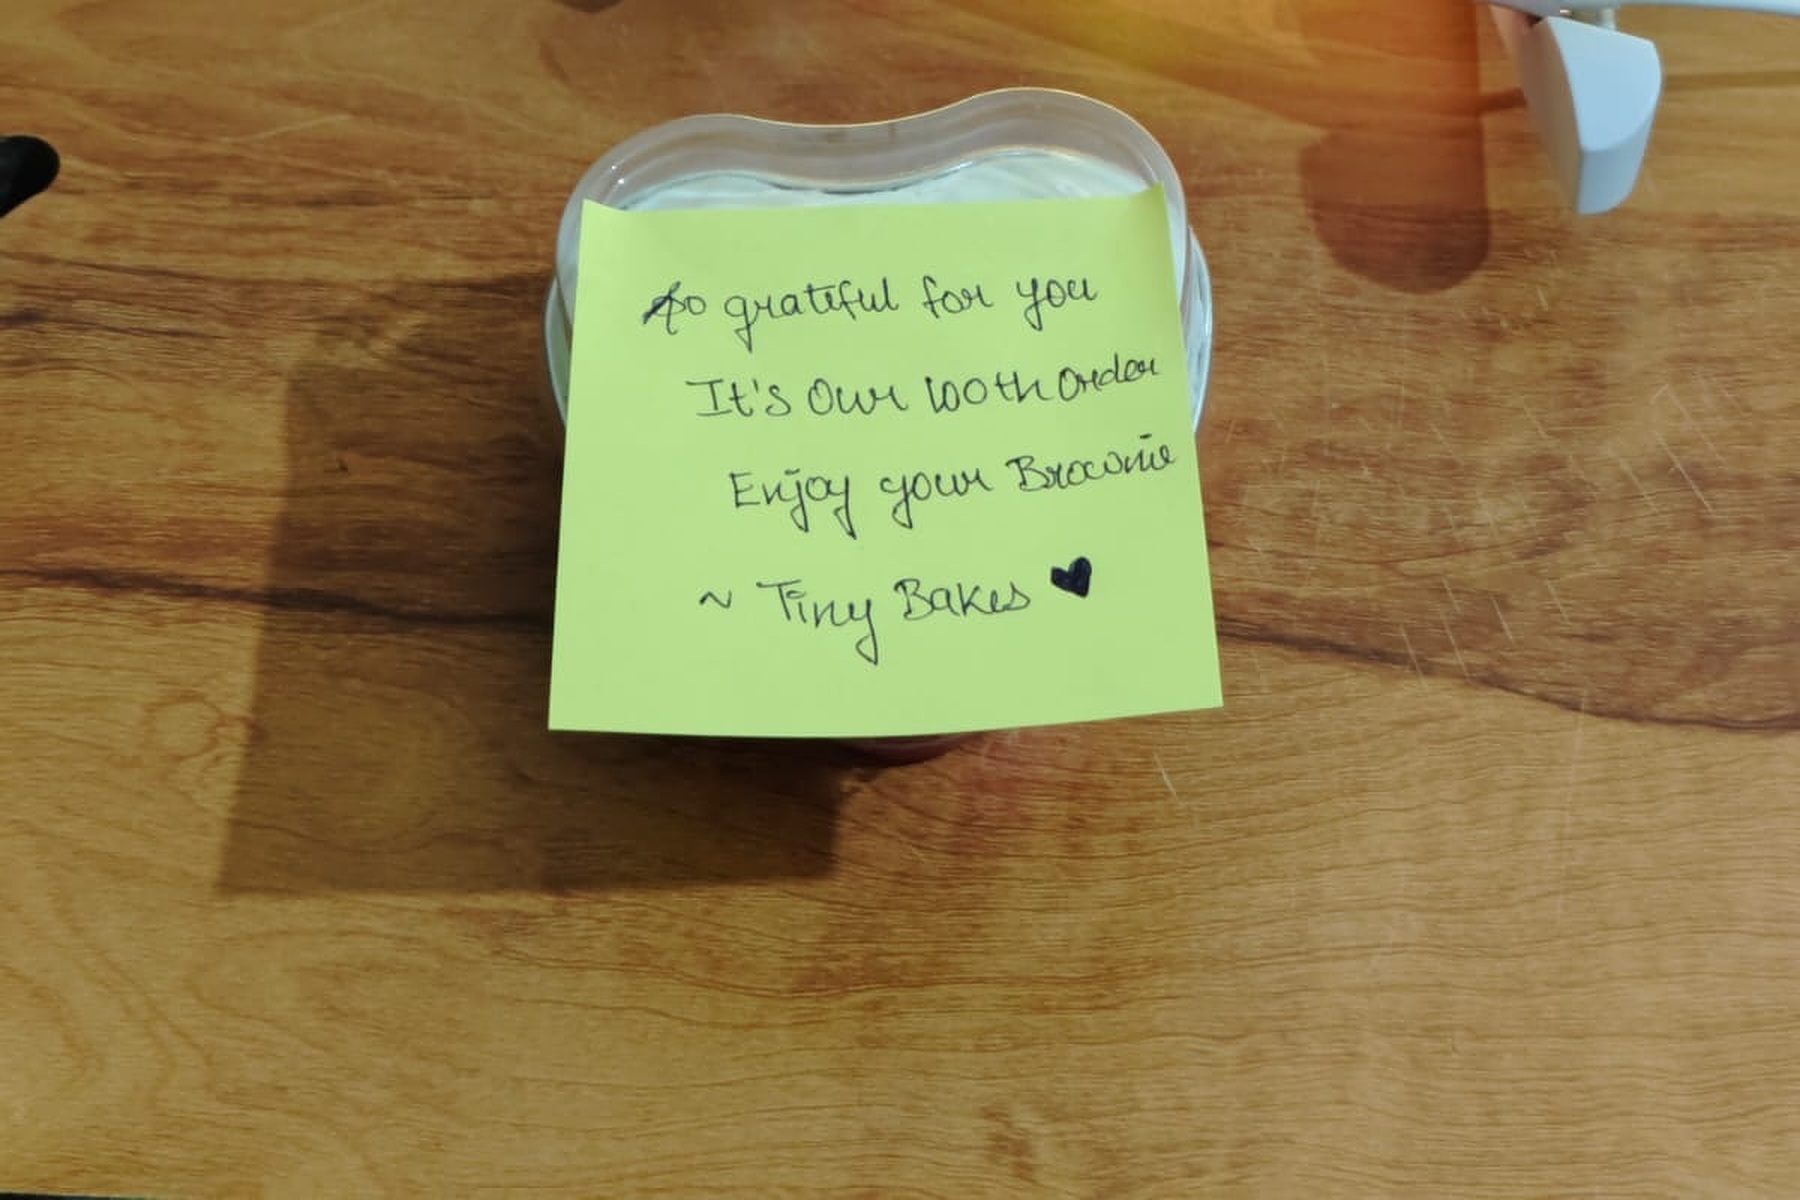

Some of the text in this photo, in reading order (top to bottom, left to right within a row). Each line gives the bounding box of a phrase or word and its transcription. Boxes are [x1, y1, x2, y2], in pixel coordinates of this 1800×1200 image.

[724, 279, 898, 353] grateful
[922, 275, 993, 319] for
[1016, 278, 1098, 331] you
[686, 378, 791, 416] It's
[730, 433, 1177, 540] Enjoy your Brownie
[756, 579, 878, 666] Tiny
[894, 577, 1031, 620] Bakes
